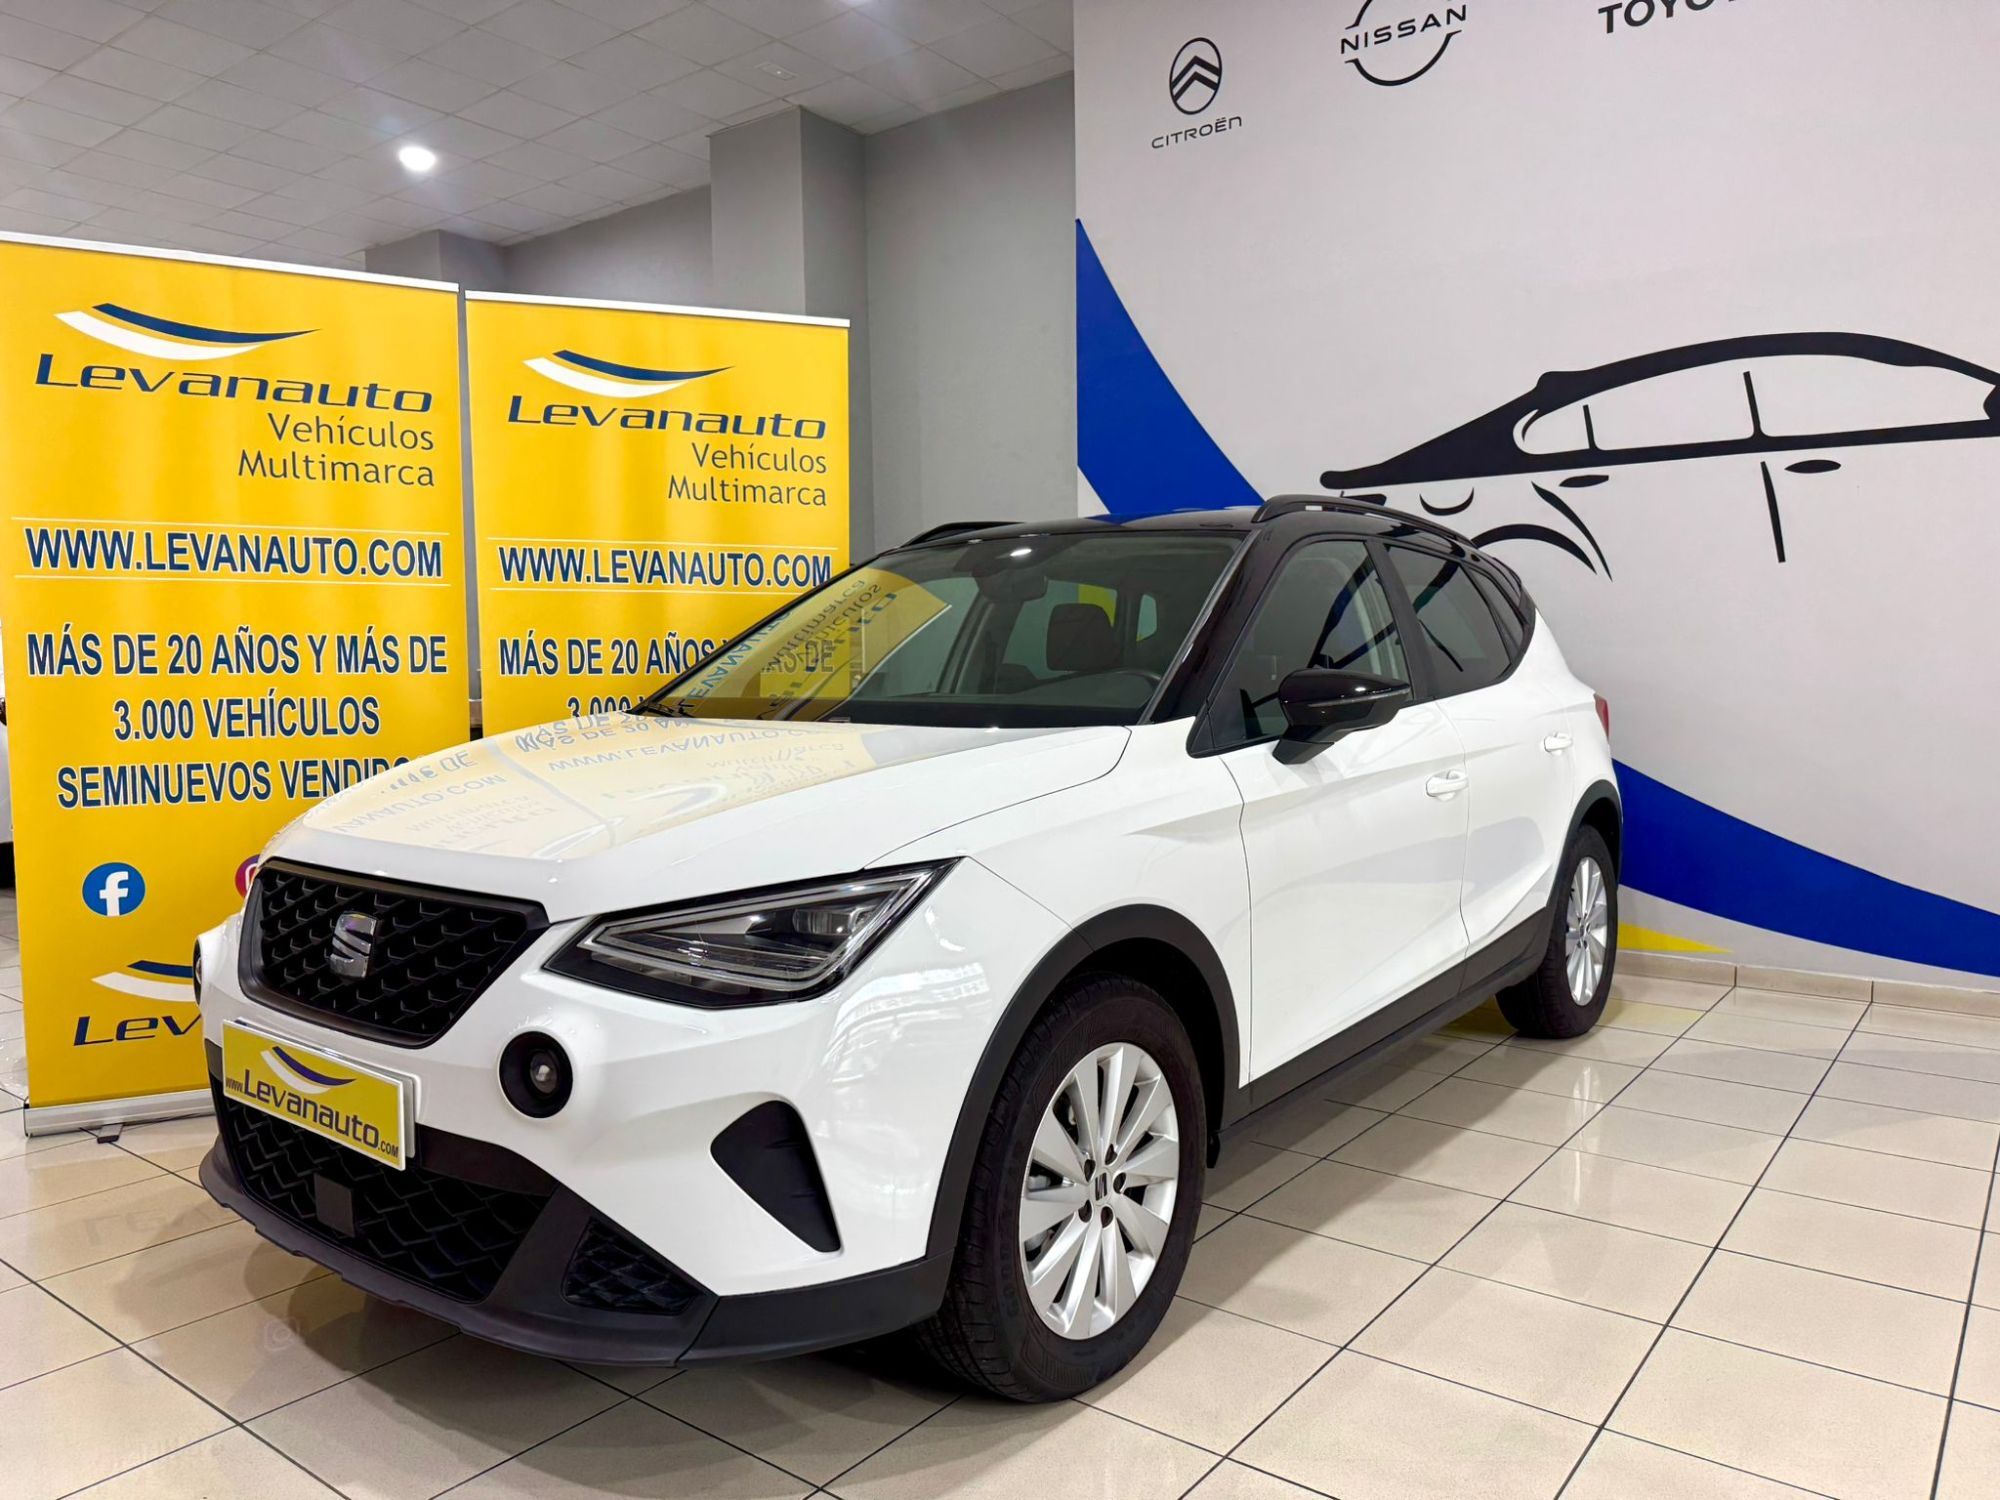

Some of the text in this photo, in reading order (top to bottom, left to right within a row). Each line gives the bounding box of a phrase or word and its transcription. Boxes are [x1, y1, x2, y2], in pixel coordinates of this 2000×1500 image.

[1340, 5, 1467, 54] NISSAN
[1151, 115, 1242, 149] CITROËN
[35, 353, 432, 413] Levanauto
[267, 412, 435, 451] Vehículos
[508, 395, 827, 439] Levanauto
[238, 449, 435, 487] Multimarca
[692, 442, 827, 474] Vehículos
[668, 475, 827, 506] Multimarca
[24, 527, 442, 578] WWW.LEVANAUTO.COM
[498, 546, 832, 587] WWW.LEVANAUTO.COM
[27, 624, 447, 676] MÁS DE 20 AÑOS Y MÁS DE
[499, 630, 559, 675] MÁS
[567, 639, 603, 675] DE
[611, 639, 643, 675] 20
[114, 688, 380, 741] 3.000 VEHÍCULOS
[58, 760, 272, 808] SEMINUEVOS
